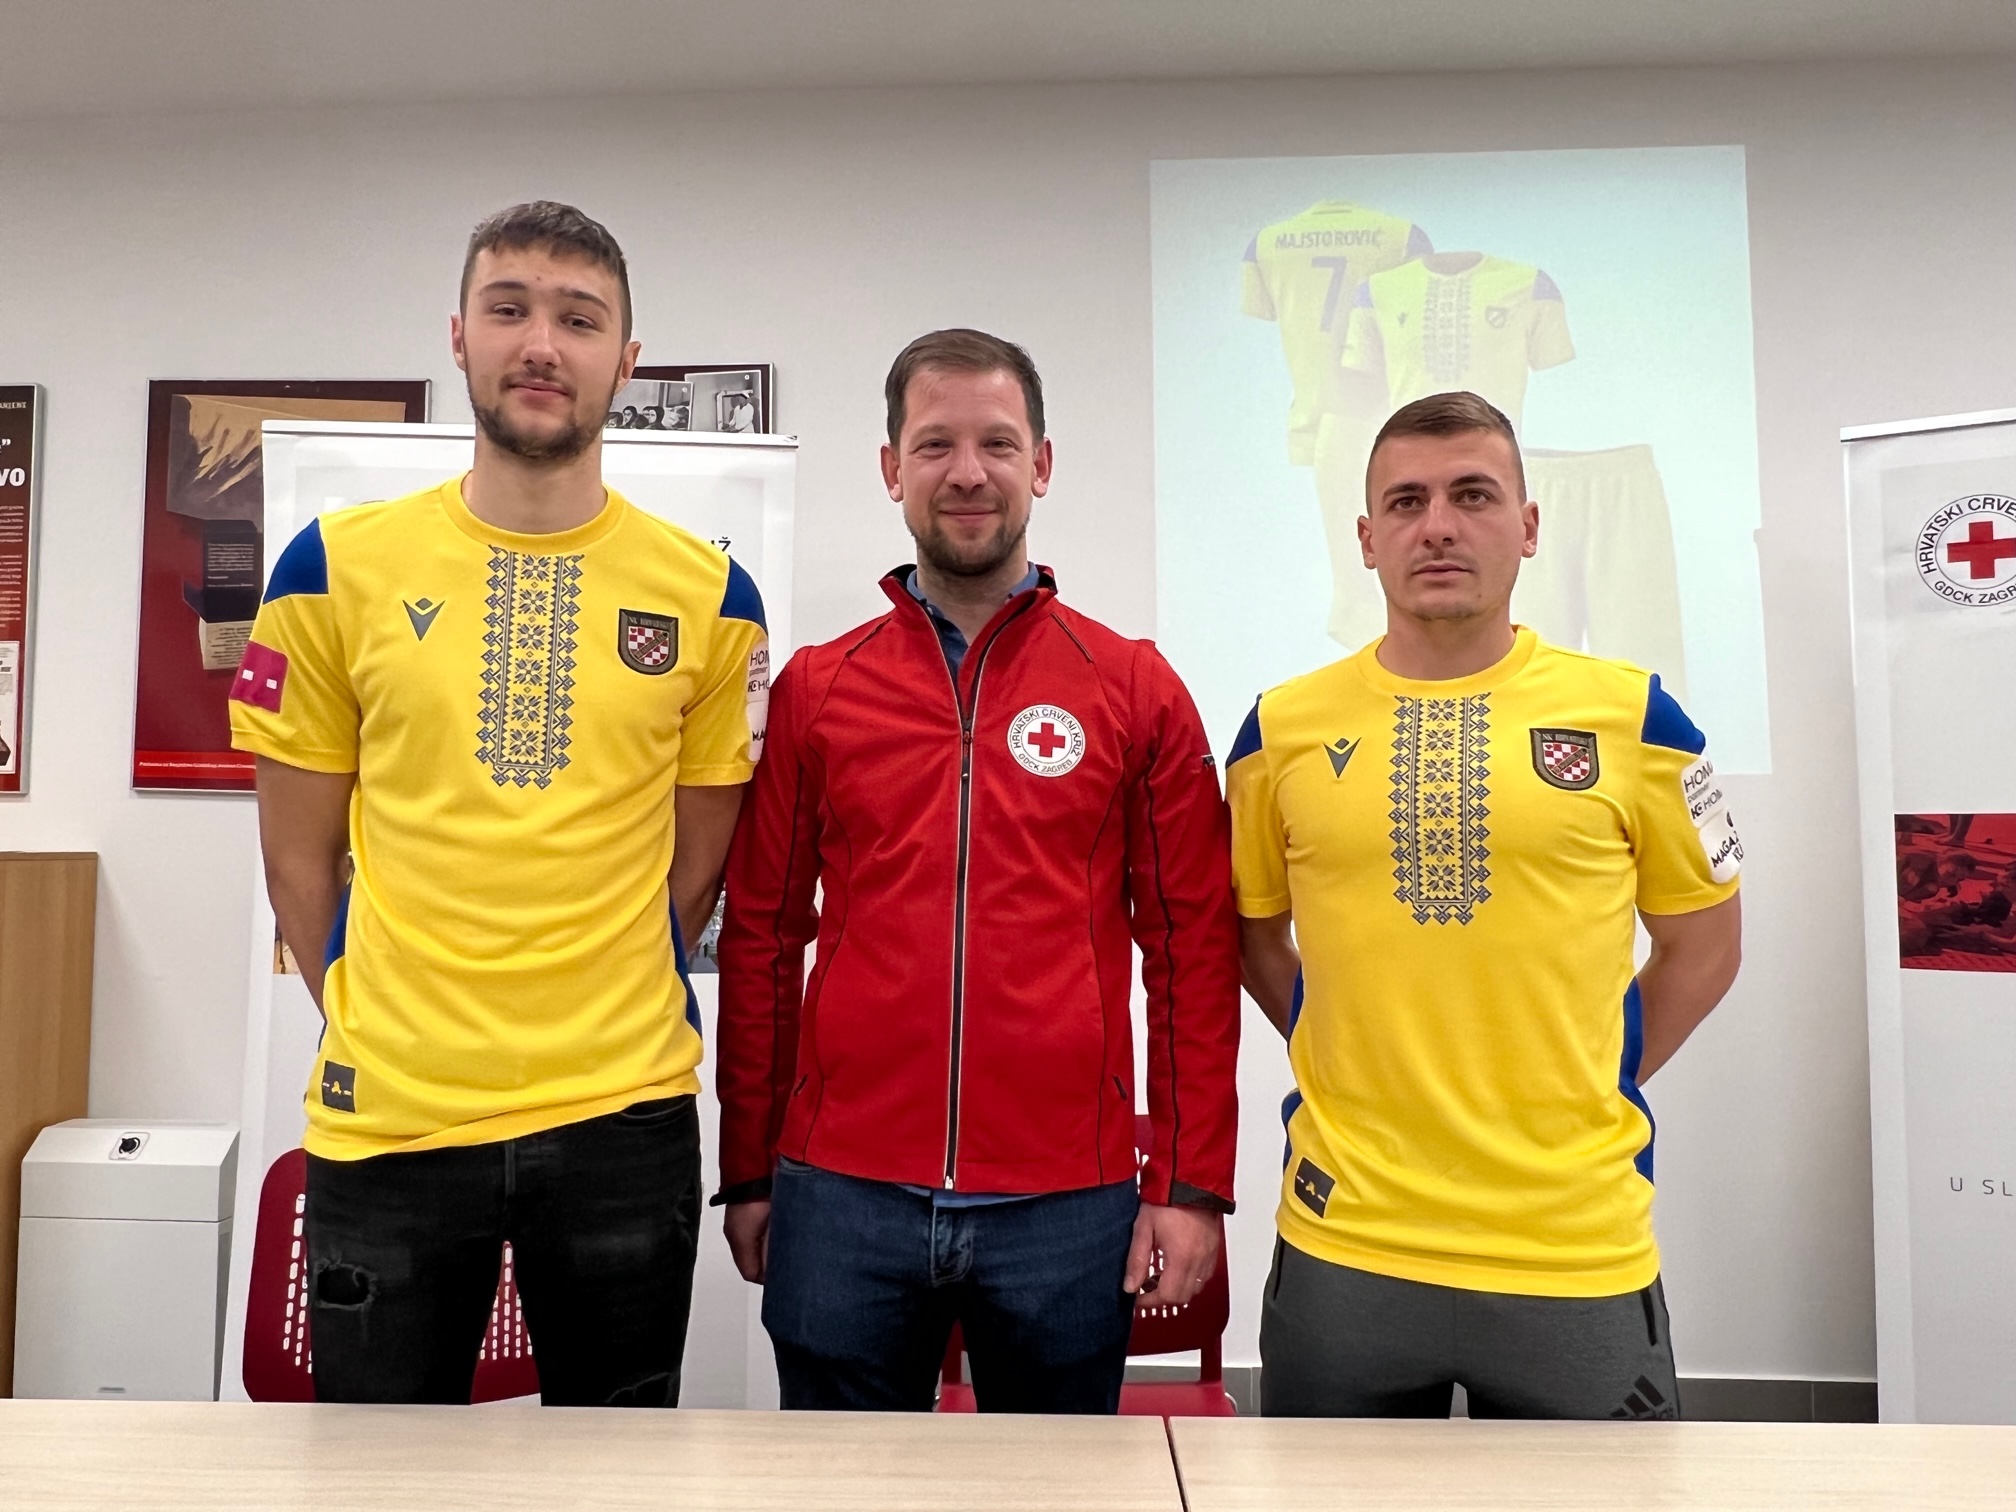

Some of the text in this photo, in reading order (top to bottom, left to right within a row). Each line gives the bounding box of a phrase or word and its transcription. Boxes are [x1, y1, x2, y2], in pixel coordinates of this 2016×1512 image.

[1311, 255, 1348, 332] 7
[1919, 503, 1964, 574] HRVATSKI
[1934, 580, 1973, 603] GDCK
[1012, 708, 1082, 757] HRVATSKI CRVENI KRIŽ
[1018, 753, 1073, 773] GDCK ZAGREB
[1950, 1176, 1962, 1192] U
